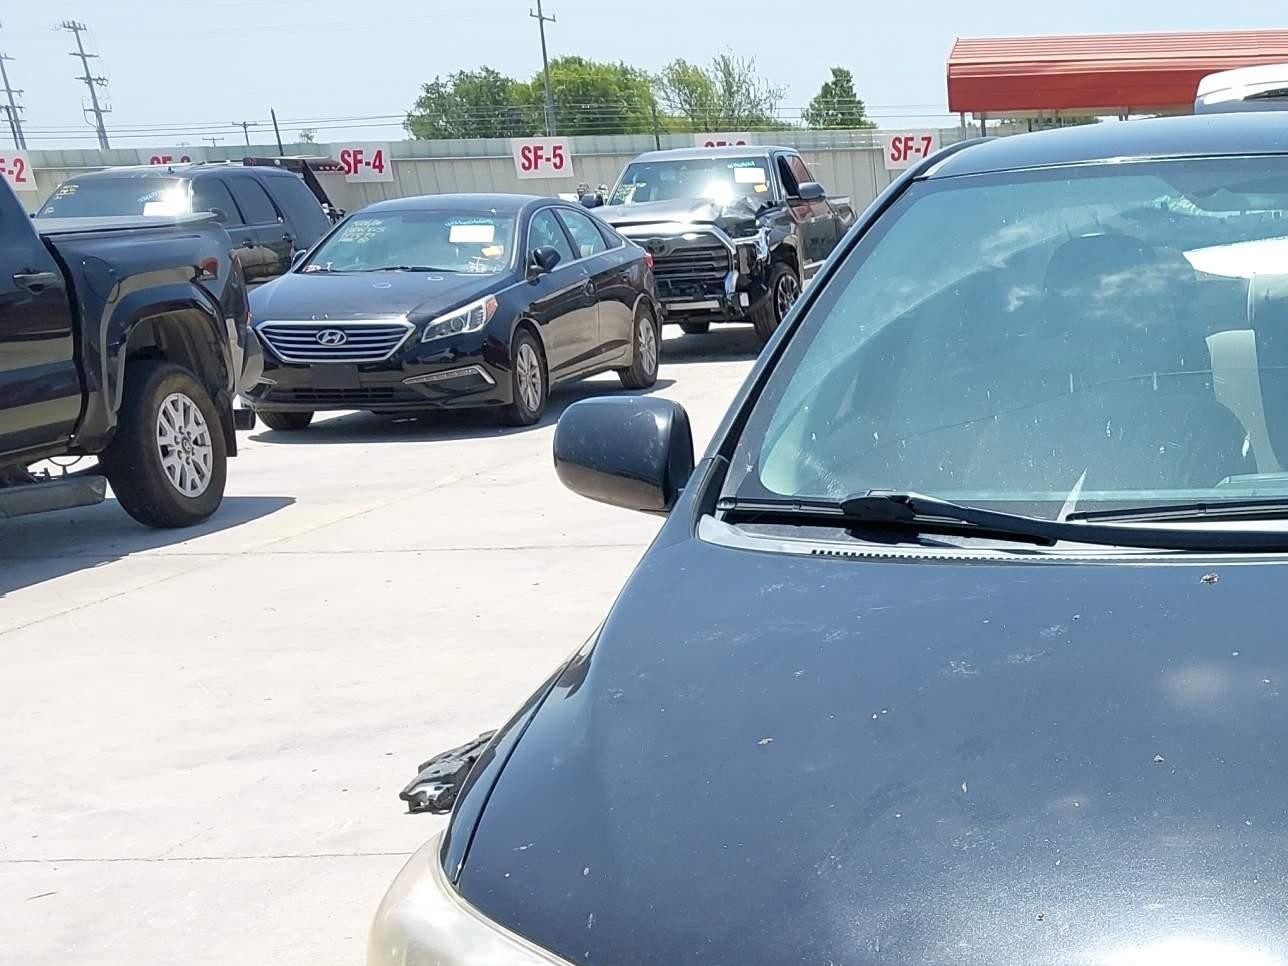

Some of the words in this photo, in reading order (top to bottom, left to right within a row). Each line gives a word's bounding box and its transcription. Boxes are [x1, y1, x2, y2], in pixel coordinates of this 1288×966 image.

[520, 145, 564, 171] SF-5
[890, 136, 932, 161] SF-7
[340, 149, 385, 175] SF-4
